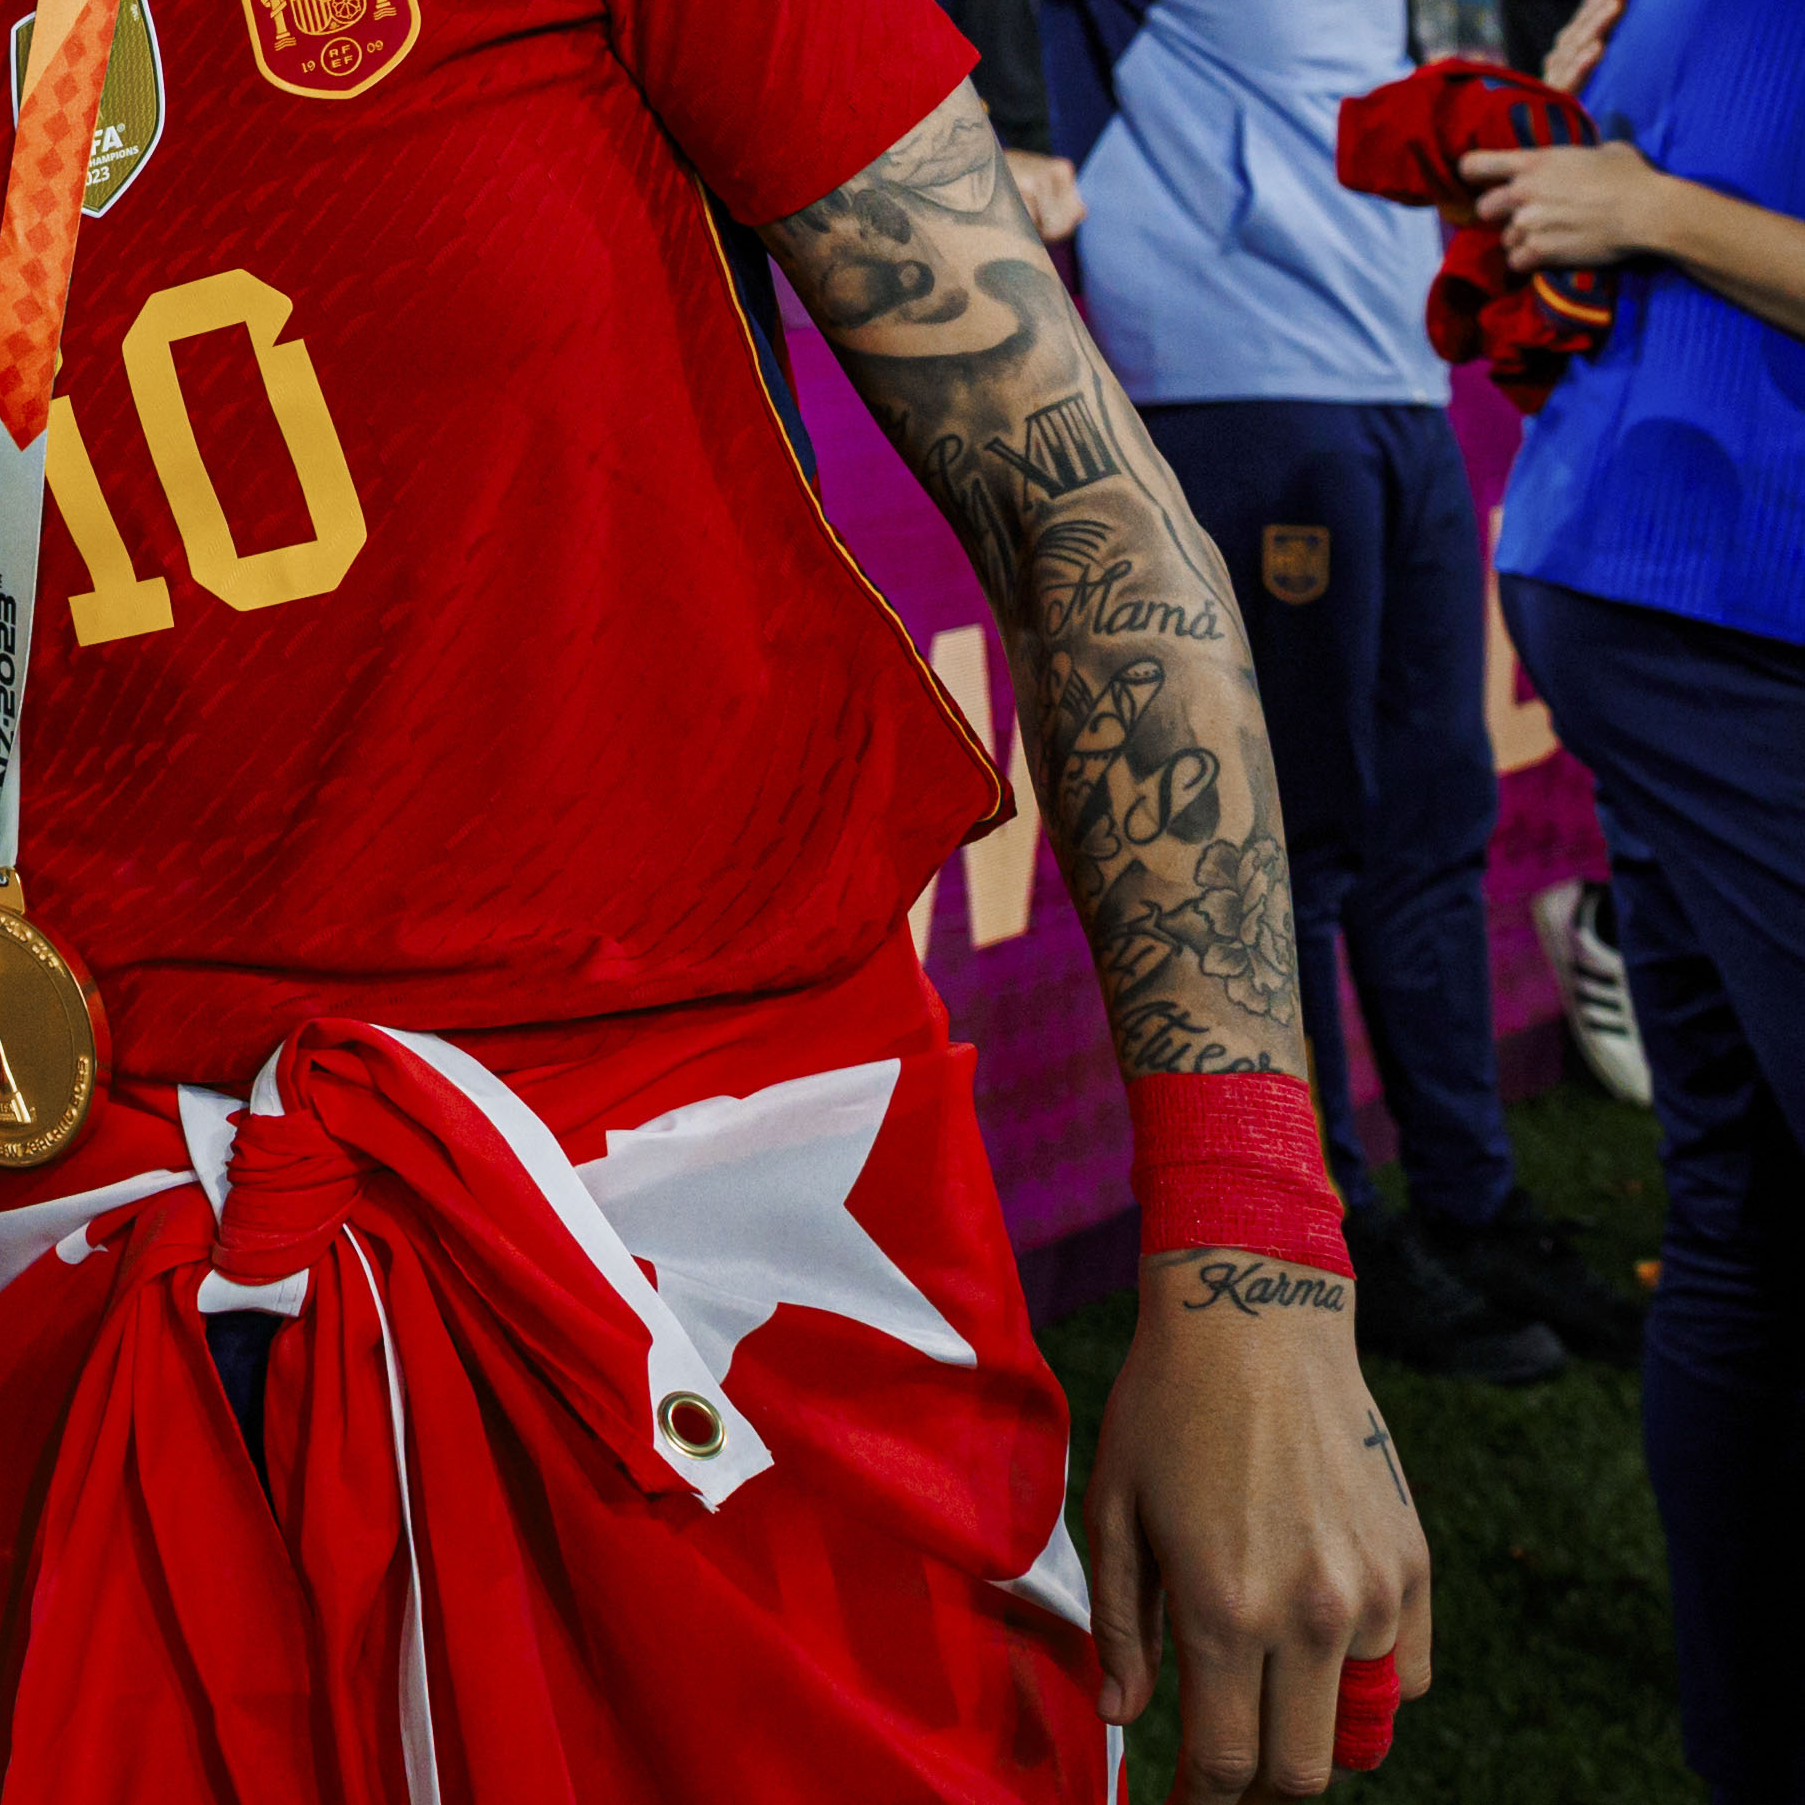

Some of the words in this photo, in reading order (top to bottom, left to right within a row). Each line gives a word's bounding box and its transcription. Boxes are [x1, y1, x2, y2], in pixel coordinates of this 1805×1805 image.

[301, 60, 316, 73] 19
[366, 40, 384, 54] 09
[45, 268, 367, 647] 10
[1183, 1262, 1345, 1317] Karma
